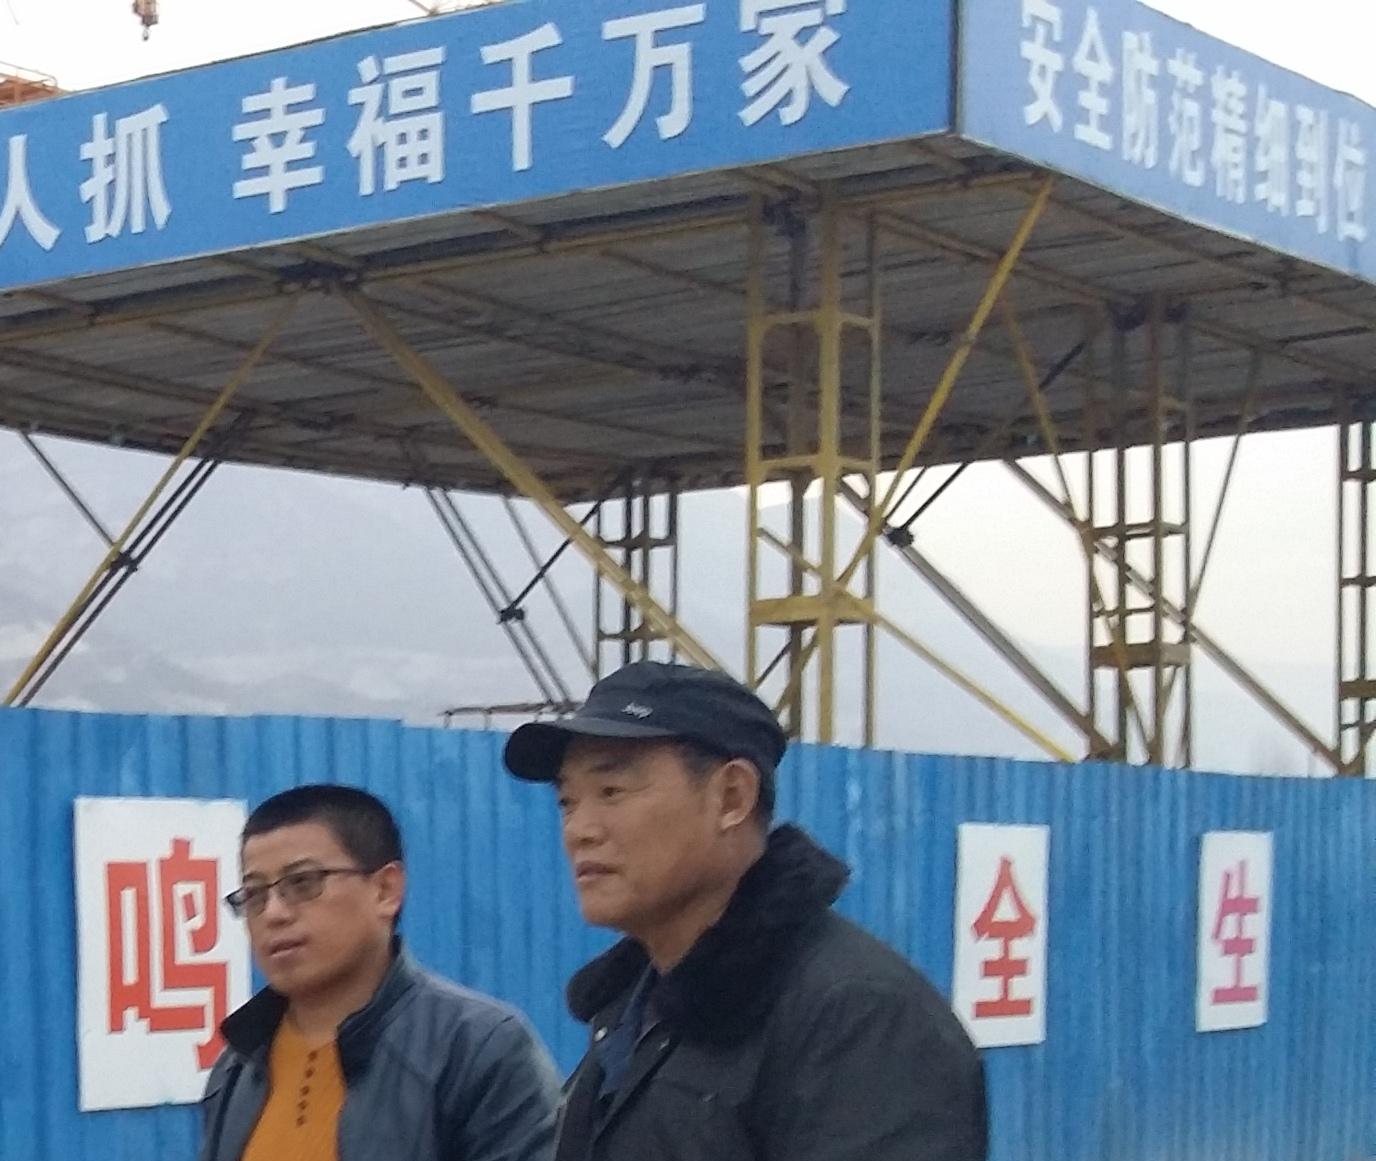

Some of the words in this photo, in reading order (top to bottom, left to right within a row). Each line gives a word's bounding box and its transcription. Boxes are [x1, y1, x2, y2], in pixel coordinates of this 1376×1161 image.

[232, 0, 850, 214] 幸福千万家
[1020, 0, 1367, 243] 安全防范精细到位
[105, 838, 229, 1071] 鸣
[972, 856, 1037, 1019] 全
[1210, 859, 1261, 1006] 生
